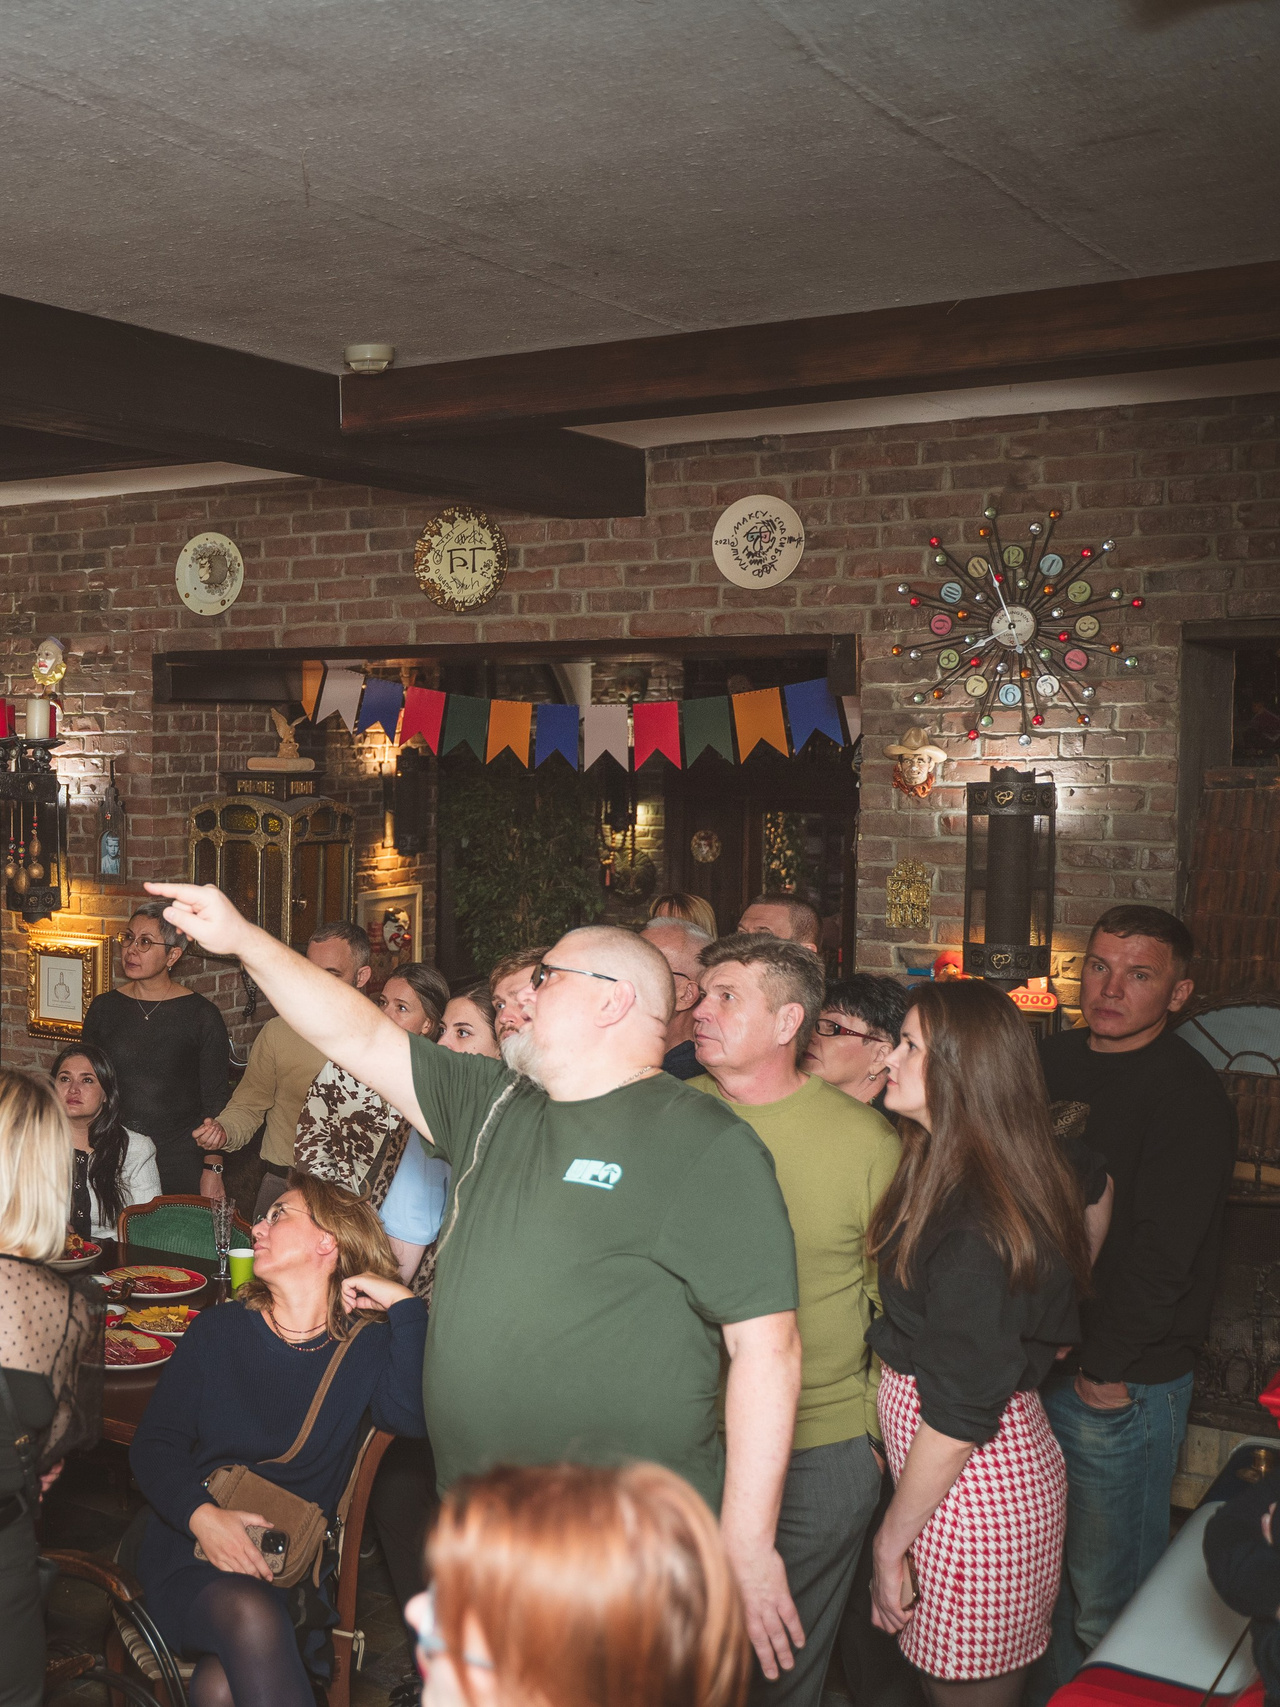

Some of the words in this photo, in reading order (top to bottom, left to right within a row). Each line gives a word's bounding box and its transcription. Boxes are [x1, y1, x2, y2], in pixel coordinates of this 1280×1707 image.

[714, 538, 730, 546] 2021
[1007, 548, 1021, 566] 12
[970, 559, 986, 577] 11
[1046, 559, 1056, 572] 1
[943, 585, 961, 601] 10
[1070, 585, 1088, 600] 2
[933, 617, 949, 631] 9
[996, 610, 1030, 624] KENINGTON
[1078, 620, 1097, 633] 3
[941, 653, 956, 666] 8
[970, 677, 985, 694] 7
[1040, 677, 1056, 694] 5
[1004, 686, 1017, 704] 6
